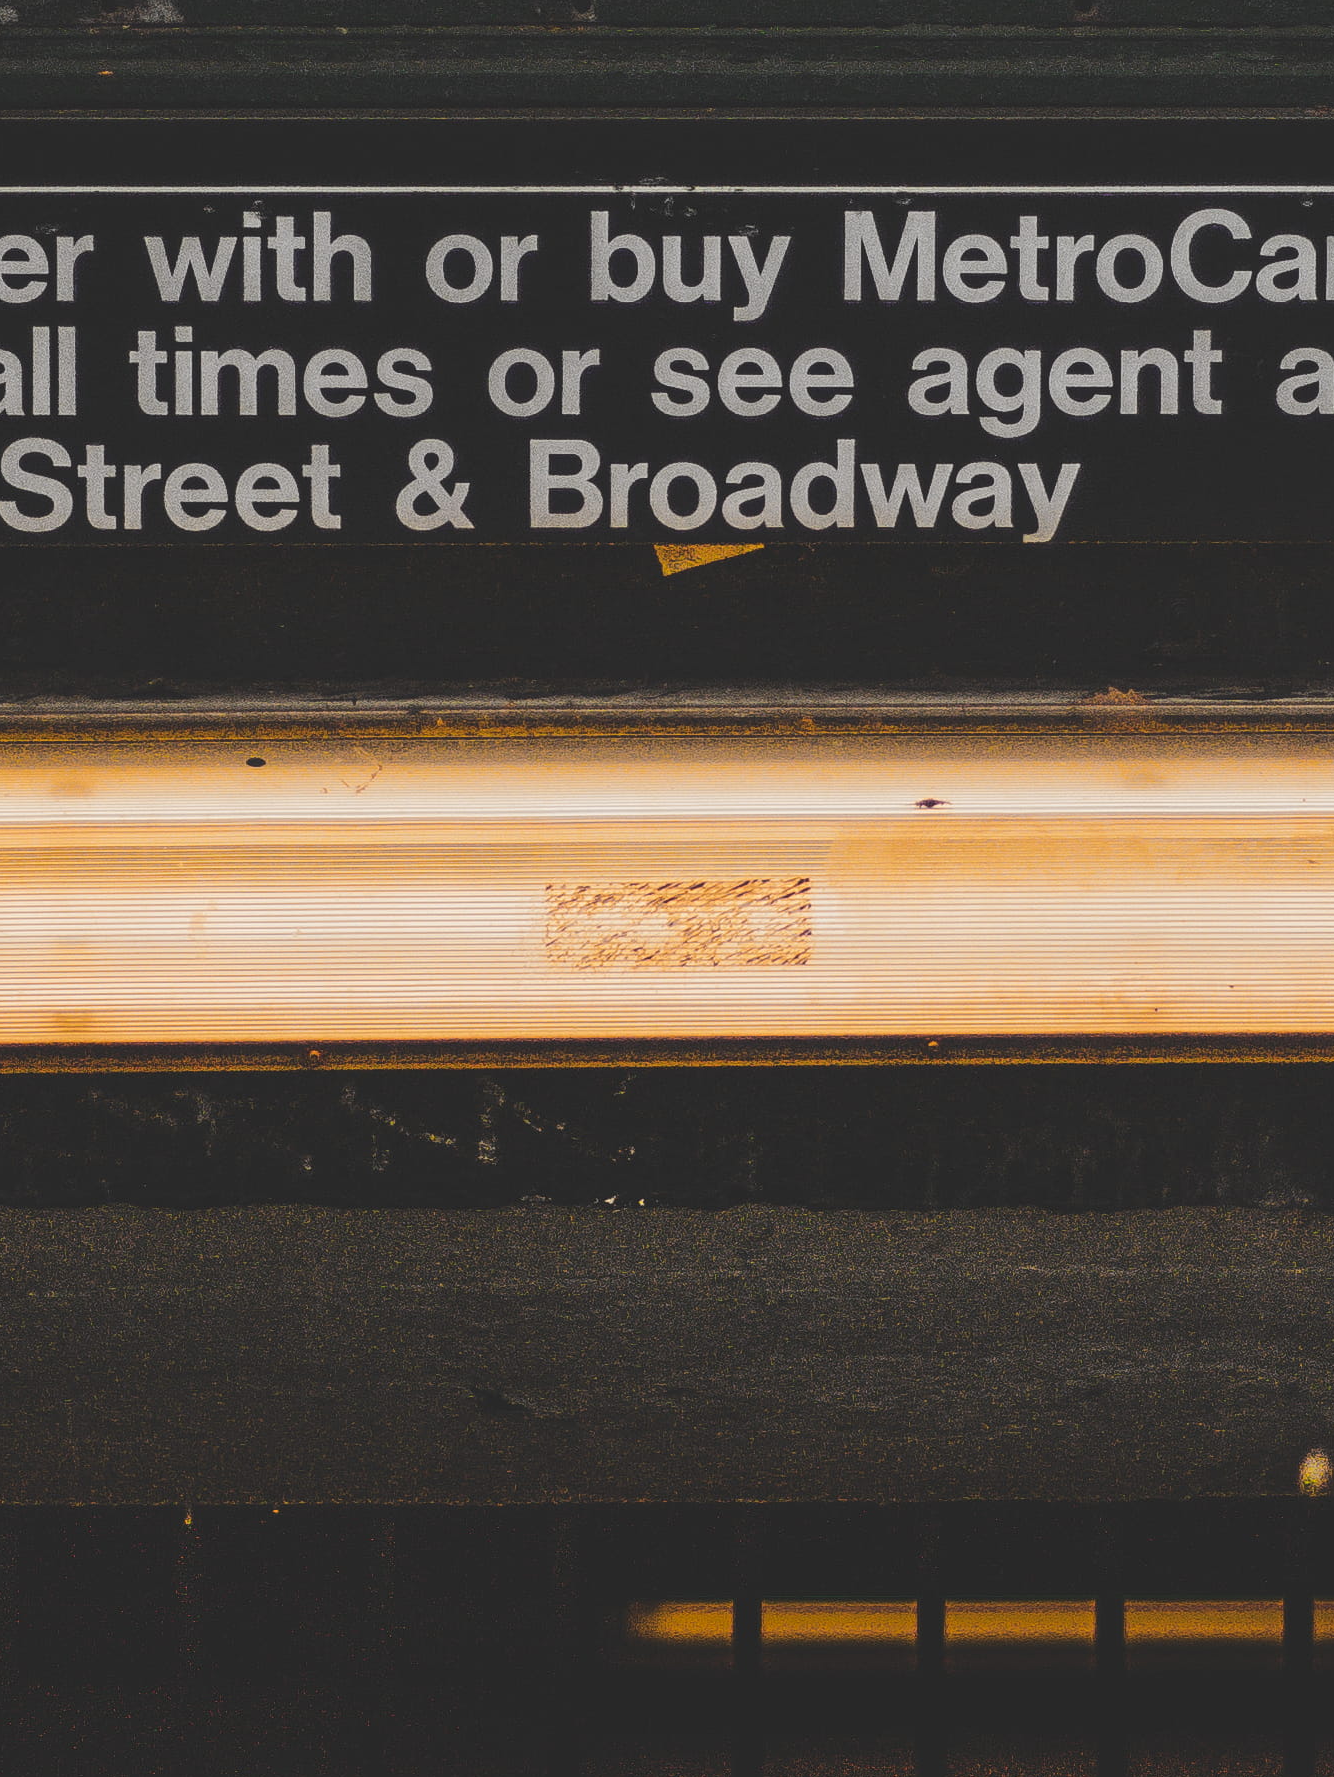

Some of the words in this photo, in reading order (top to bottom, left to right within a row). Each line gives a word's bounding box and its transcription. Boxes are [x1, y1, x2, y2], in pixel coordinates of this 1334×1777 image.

[143, 210, 373, 303] with
[425, 233, 539, 304] or
[590, 210, 792, 323] buy
[128, 324, 434, 419] times
[487, 347, 601, 418] or
[650, 347, 855, 417] see
[907, 329, 1223, 439] agent
[395, 438, 476, 532] &
[529, 438, 1082, 544] Broadway
